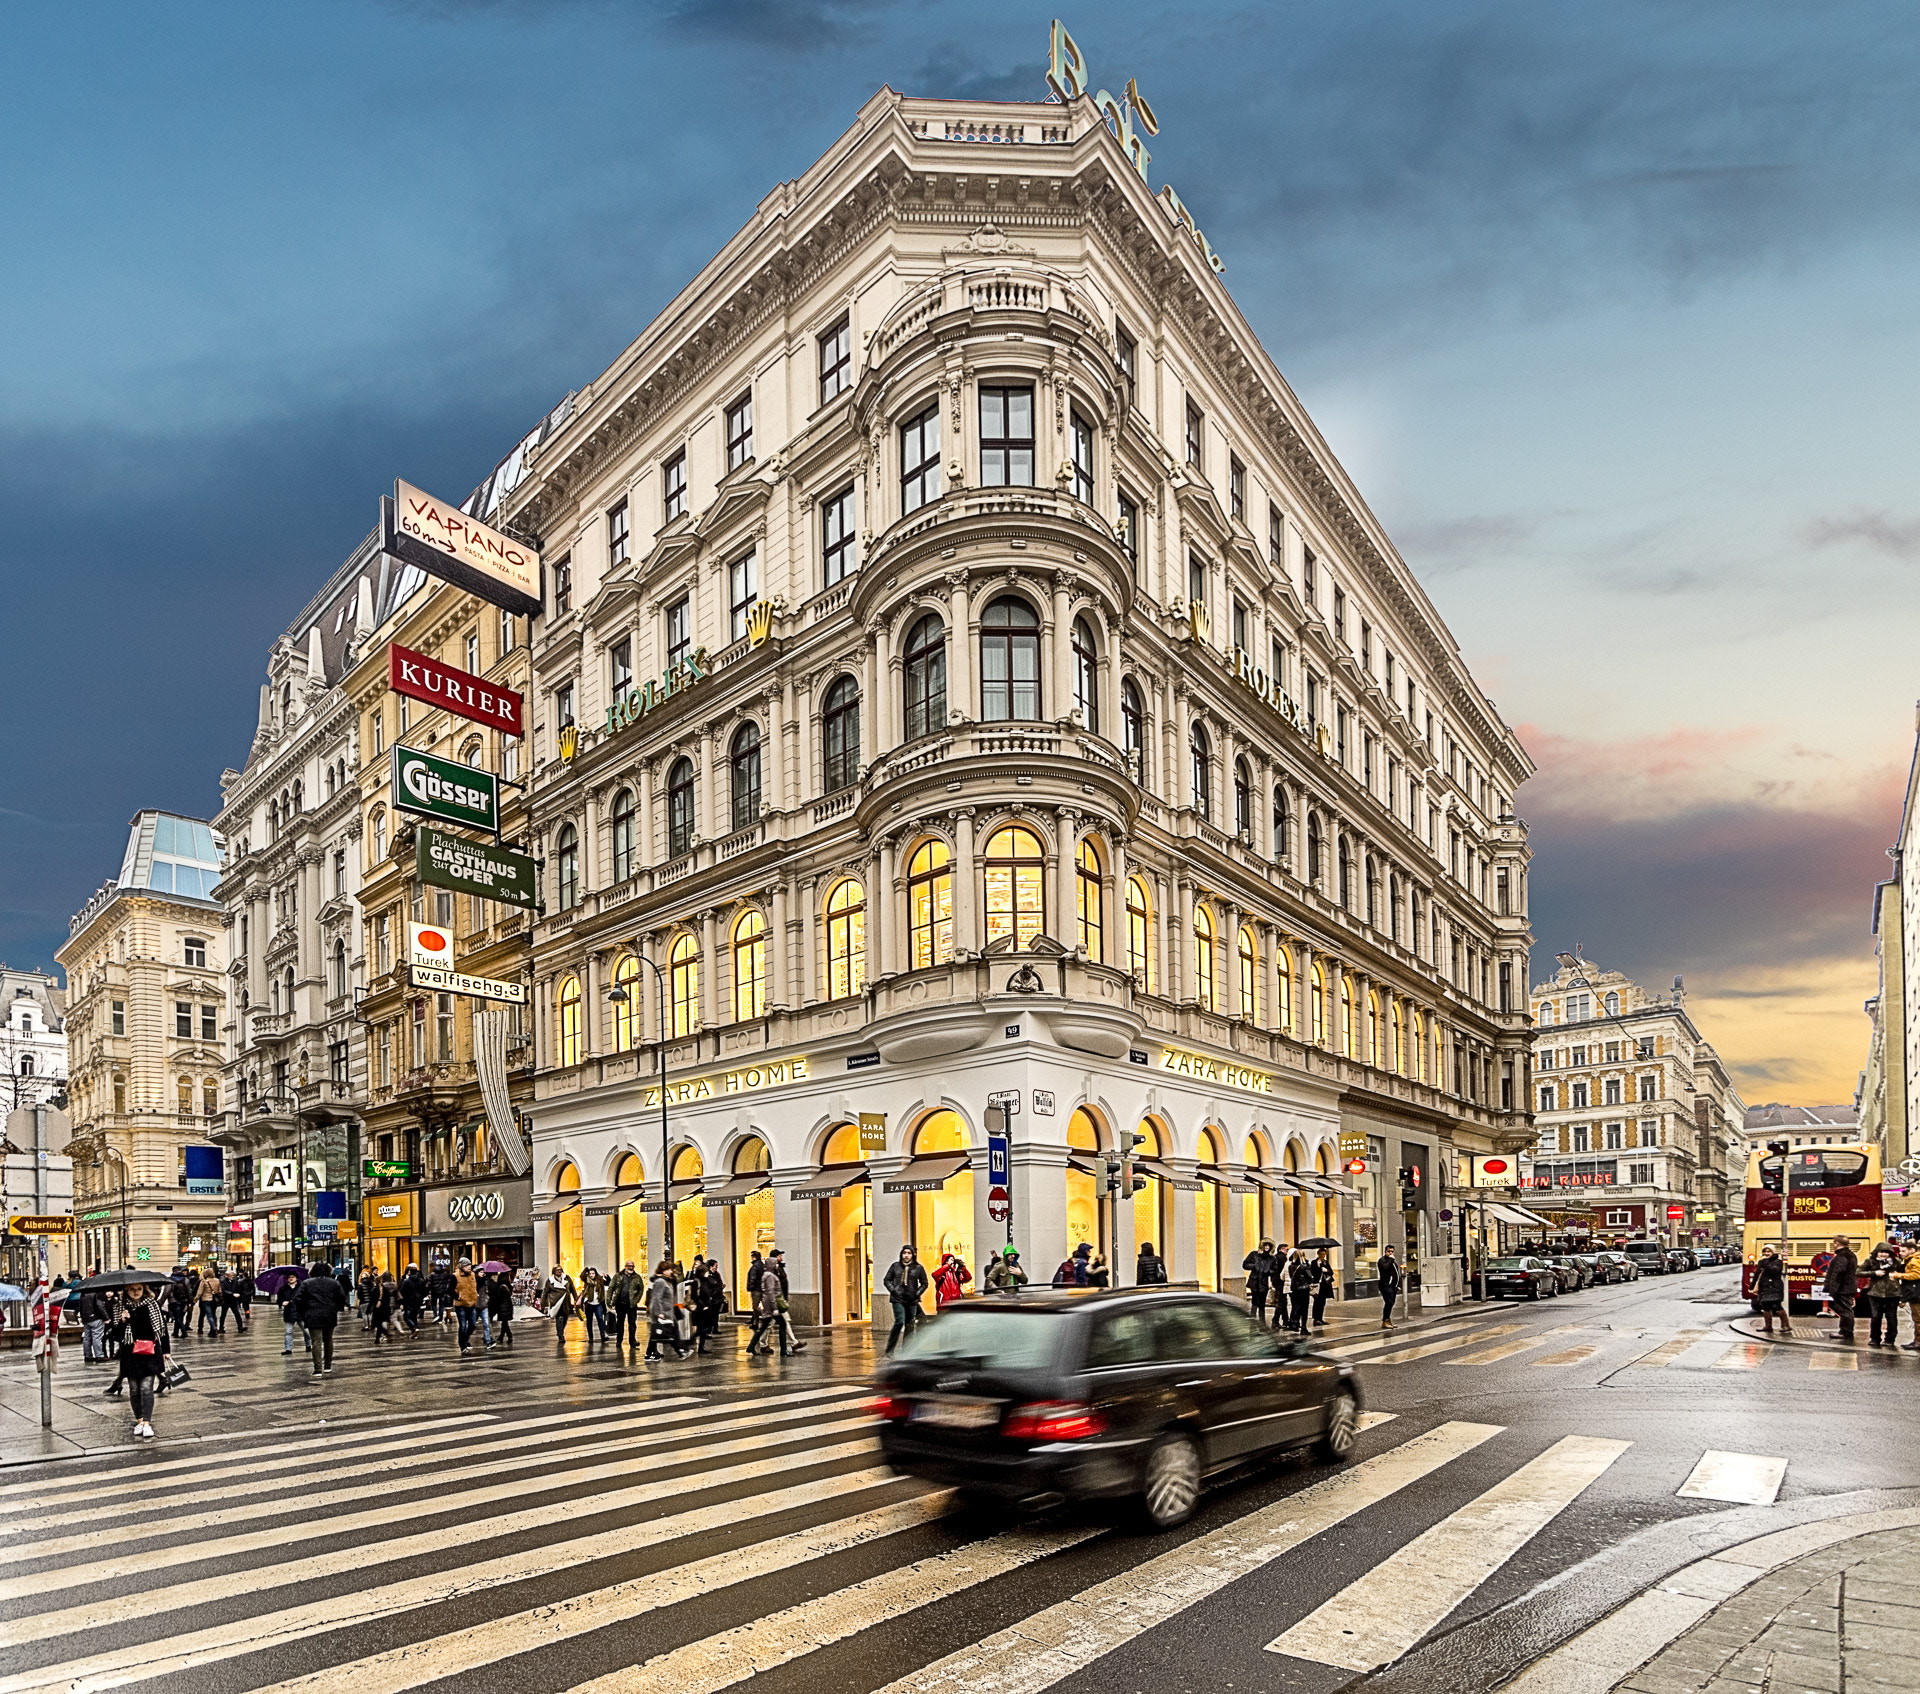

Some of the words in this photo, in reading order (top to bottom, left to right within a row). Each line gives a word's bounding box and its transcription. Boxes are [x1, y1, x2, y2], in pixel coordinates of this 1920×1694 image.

[464, 546, 485, 562] PASTA
[492, 561, 510, 574] PIZZA
[517, 573, 531, 585] BAR
[400, 658, 515, 722] KURIER
[605, 648, 706, 736] ROLEX
[1236, 646, 1303, 734] ROLEX
[402, 759, 491, 814] Gösser
[431, 833, 486, 858] Plachuttas
[430, 846, 517, 879] GASTHAUS
[432, 859, 450, 870] zur
[449, 862, 494, 886] OPER
[499, 887, 510, 898] 50
[415, 952, 449, 969] Turek
[1164, 1049, 1218, 1080] ZARA
[1226, 1066, 1273, 1093] HOME
[645, 1079, 711, 1108] ZARA
[725, 1059, 807, 1092] HOME
[862, 1123, 884, 1131] ZARA
[861, 1132, 885, 1140] HOME
[1341, 1138, 1364, 1146] ZARA
[889, 1184, 910, 1192] ZARA
[1480, 1177, 1510, 1186] Turek
[1559, 1173, 1612, 1186] ROUGE
[189, 1186, 215, 1194] ERSTE
[1794, 1197, 1814, 1206] BIG
[24, 1220, 62, 1229] Albertina
